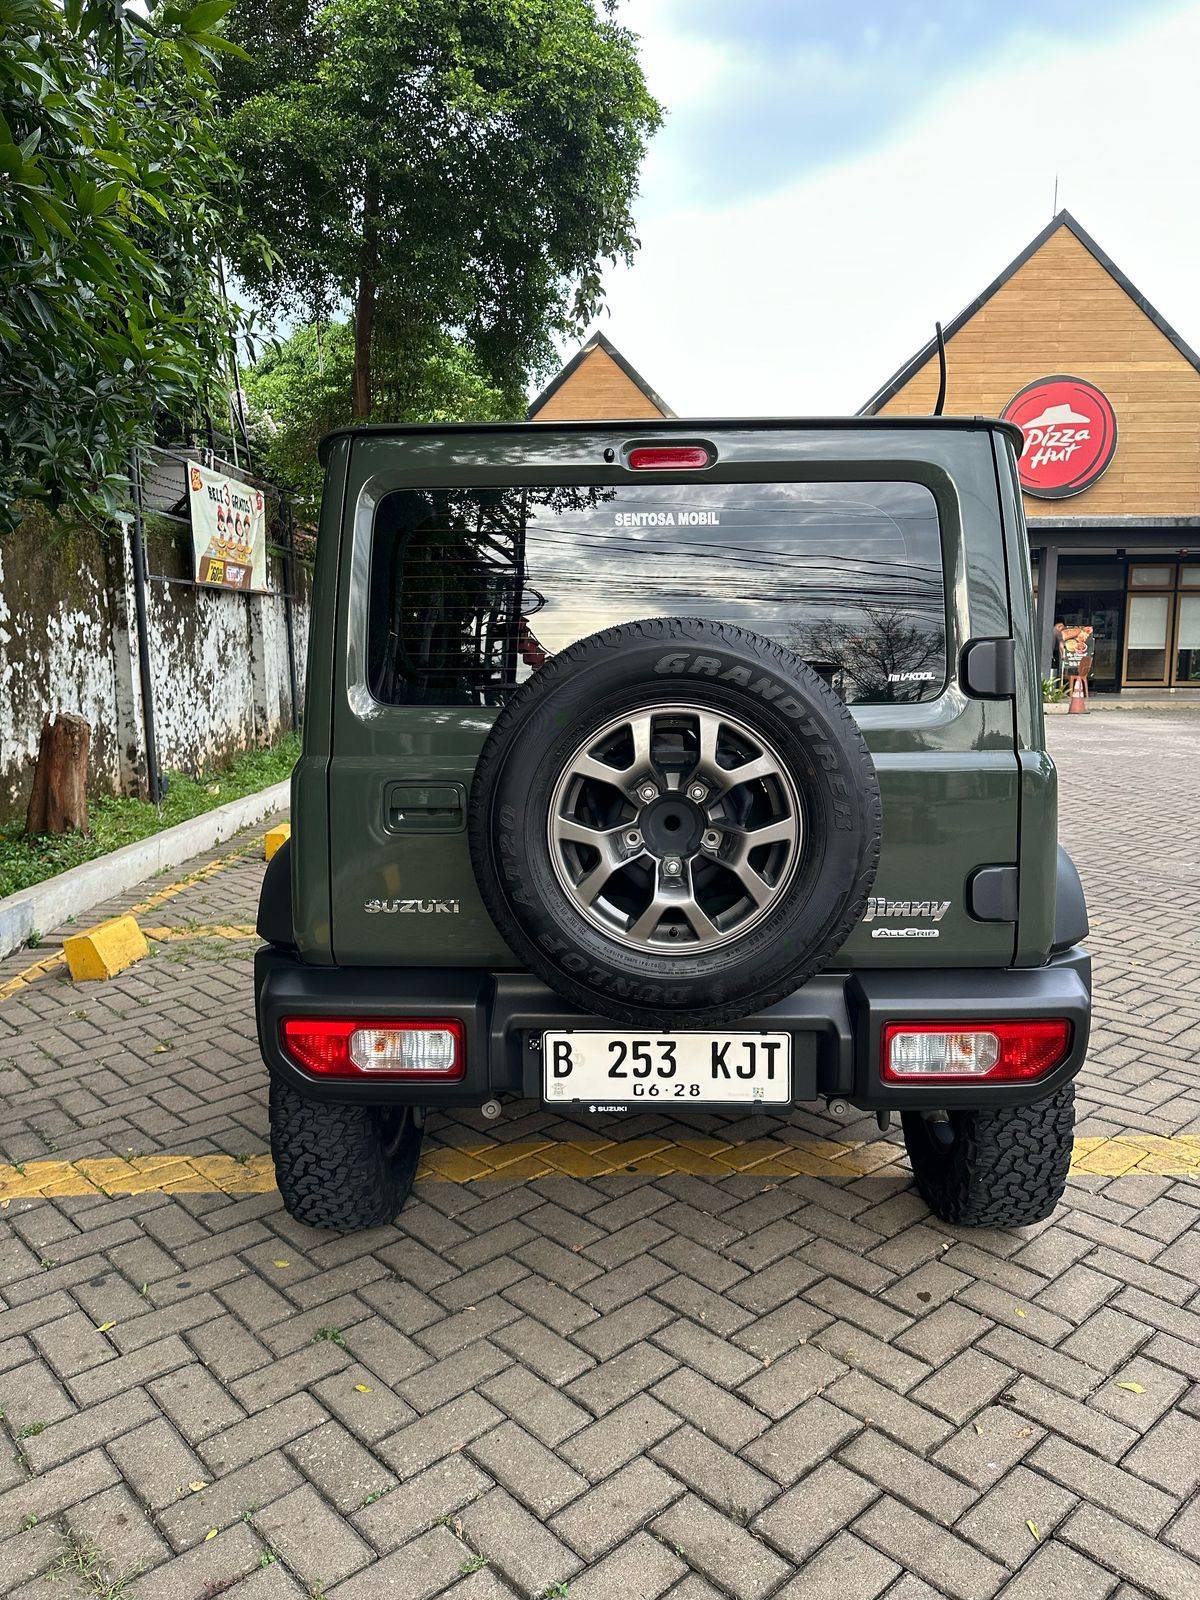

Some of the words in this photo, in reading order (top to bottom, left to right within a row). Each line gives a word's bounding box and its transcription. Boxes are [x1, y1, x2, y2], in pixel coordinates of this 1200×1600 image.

[1022, 424, 1091, 457] Pizza
[1030, 443, 1082, 469] Hut
[207, 485, 224, 504] BELI
[223, 483, 231, 507] 3
[614, 511, 675, 527] SENTOSA
[678, 511, 720, 526] MOBIL
[653, 653, 853, 832] GRANDTREK
[363, 899, 460, 914] SUZUKI
[862, 897, 952, 922] Jimny
[537, 932, 693, 1004] DUNLOP
[553, 1040, 574, 1079] B
[608, 1040, 677, 1079] 253
[711, 1041, 781, 1080] KJT
